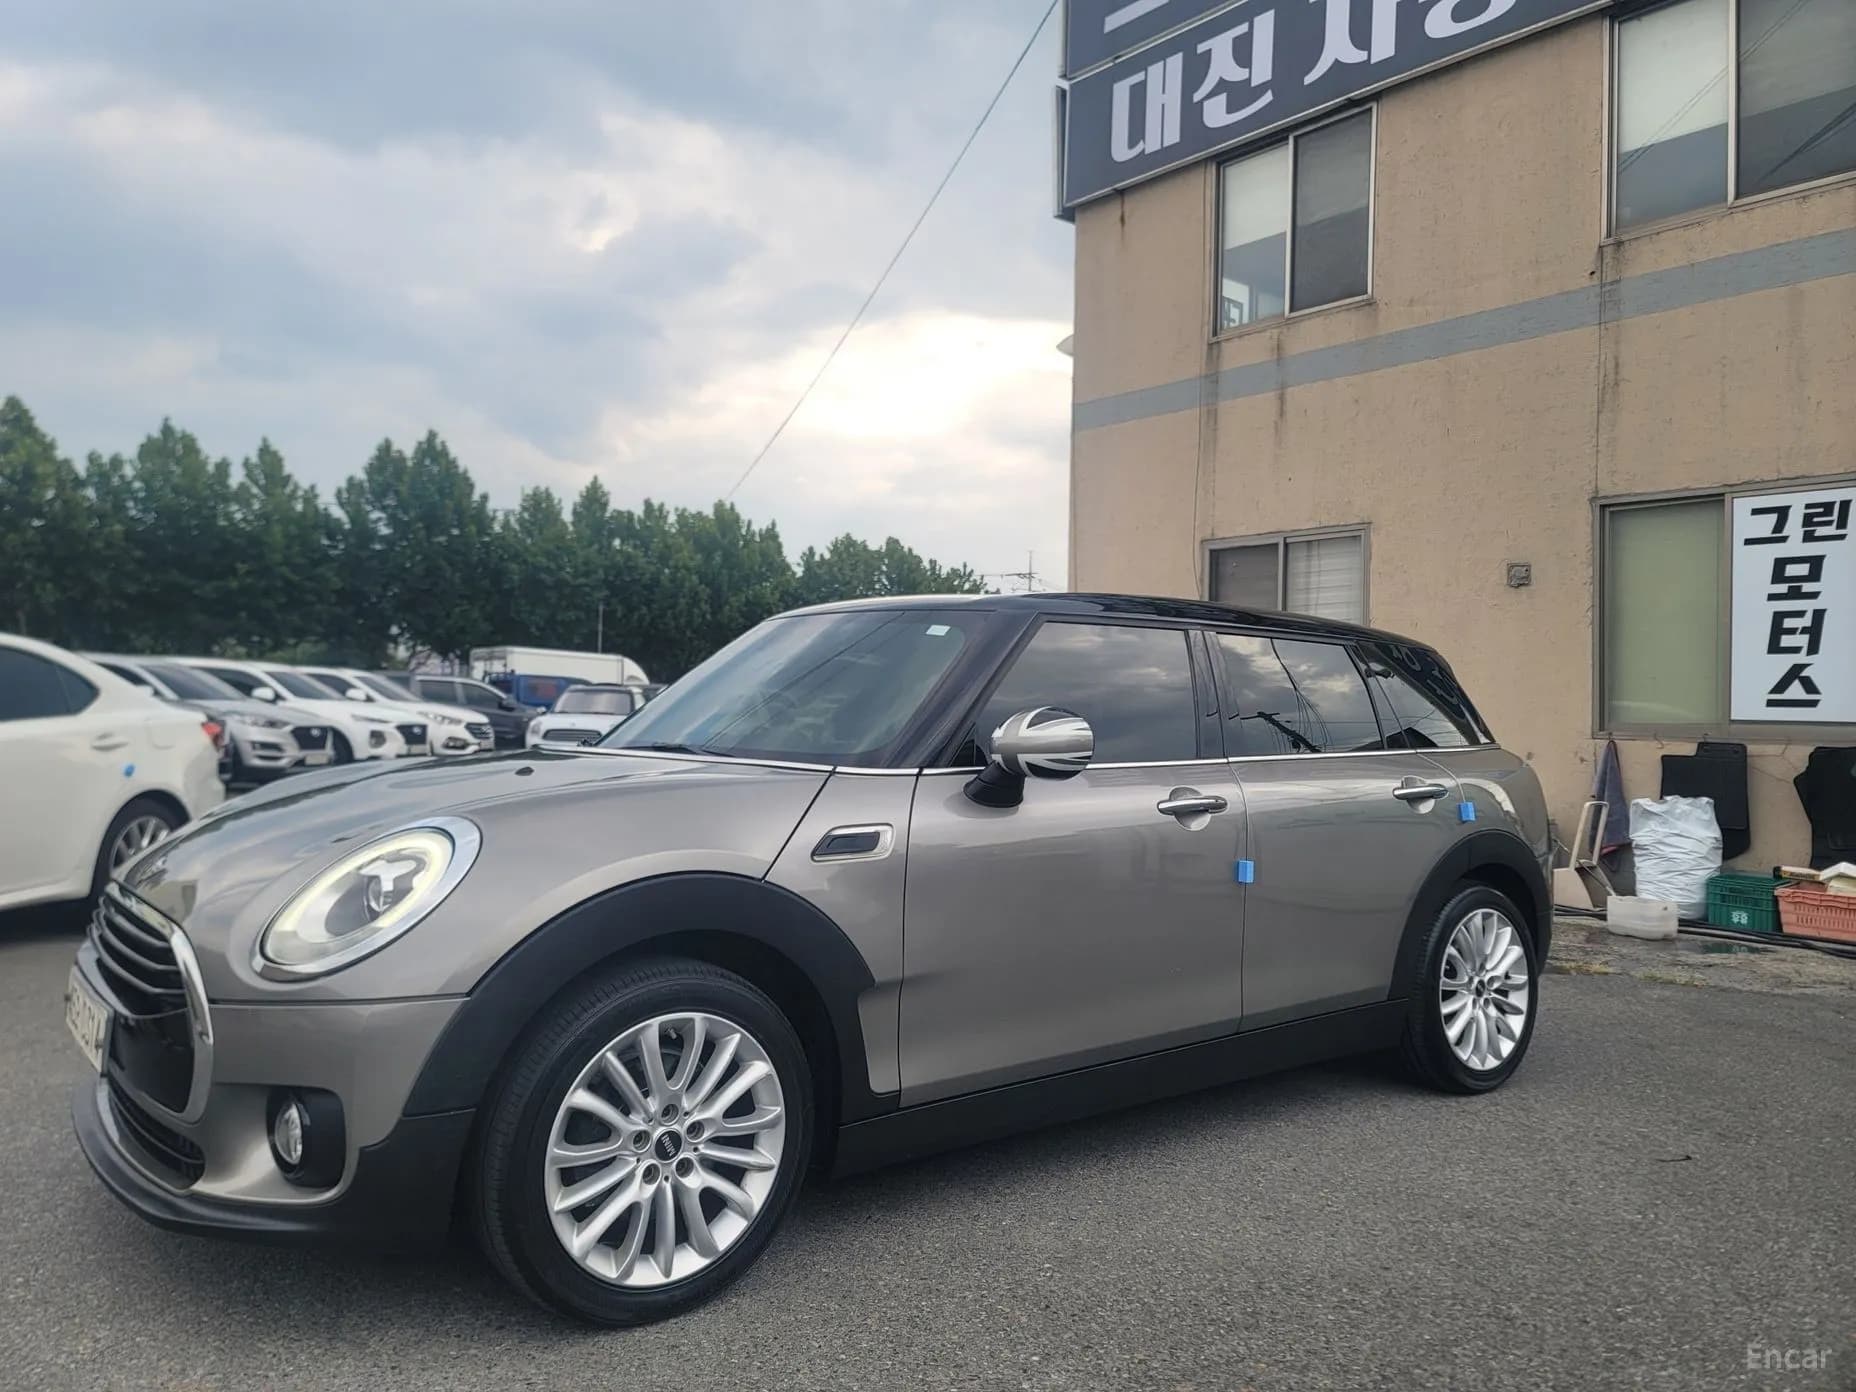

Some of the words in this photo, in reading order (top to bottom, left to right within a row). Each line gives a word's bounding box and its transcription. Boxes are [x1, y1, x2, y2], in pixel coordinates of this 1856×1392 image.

[1111, 8, 1275, 162] 대진
[1743, 499, 1853, 546] 그린
[1766, 554, 1828, 708] 모터스
[661, 1134, 677, 1157] MINI
